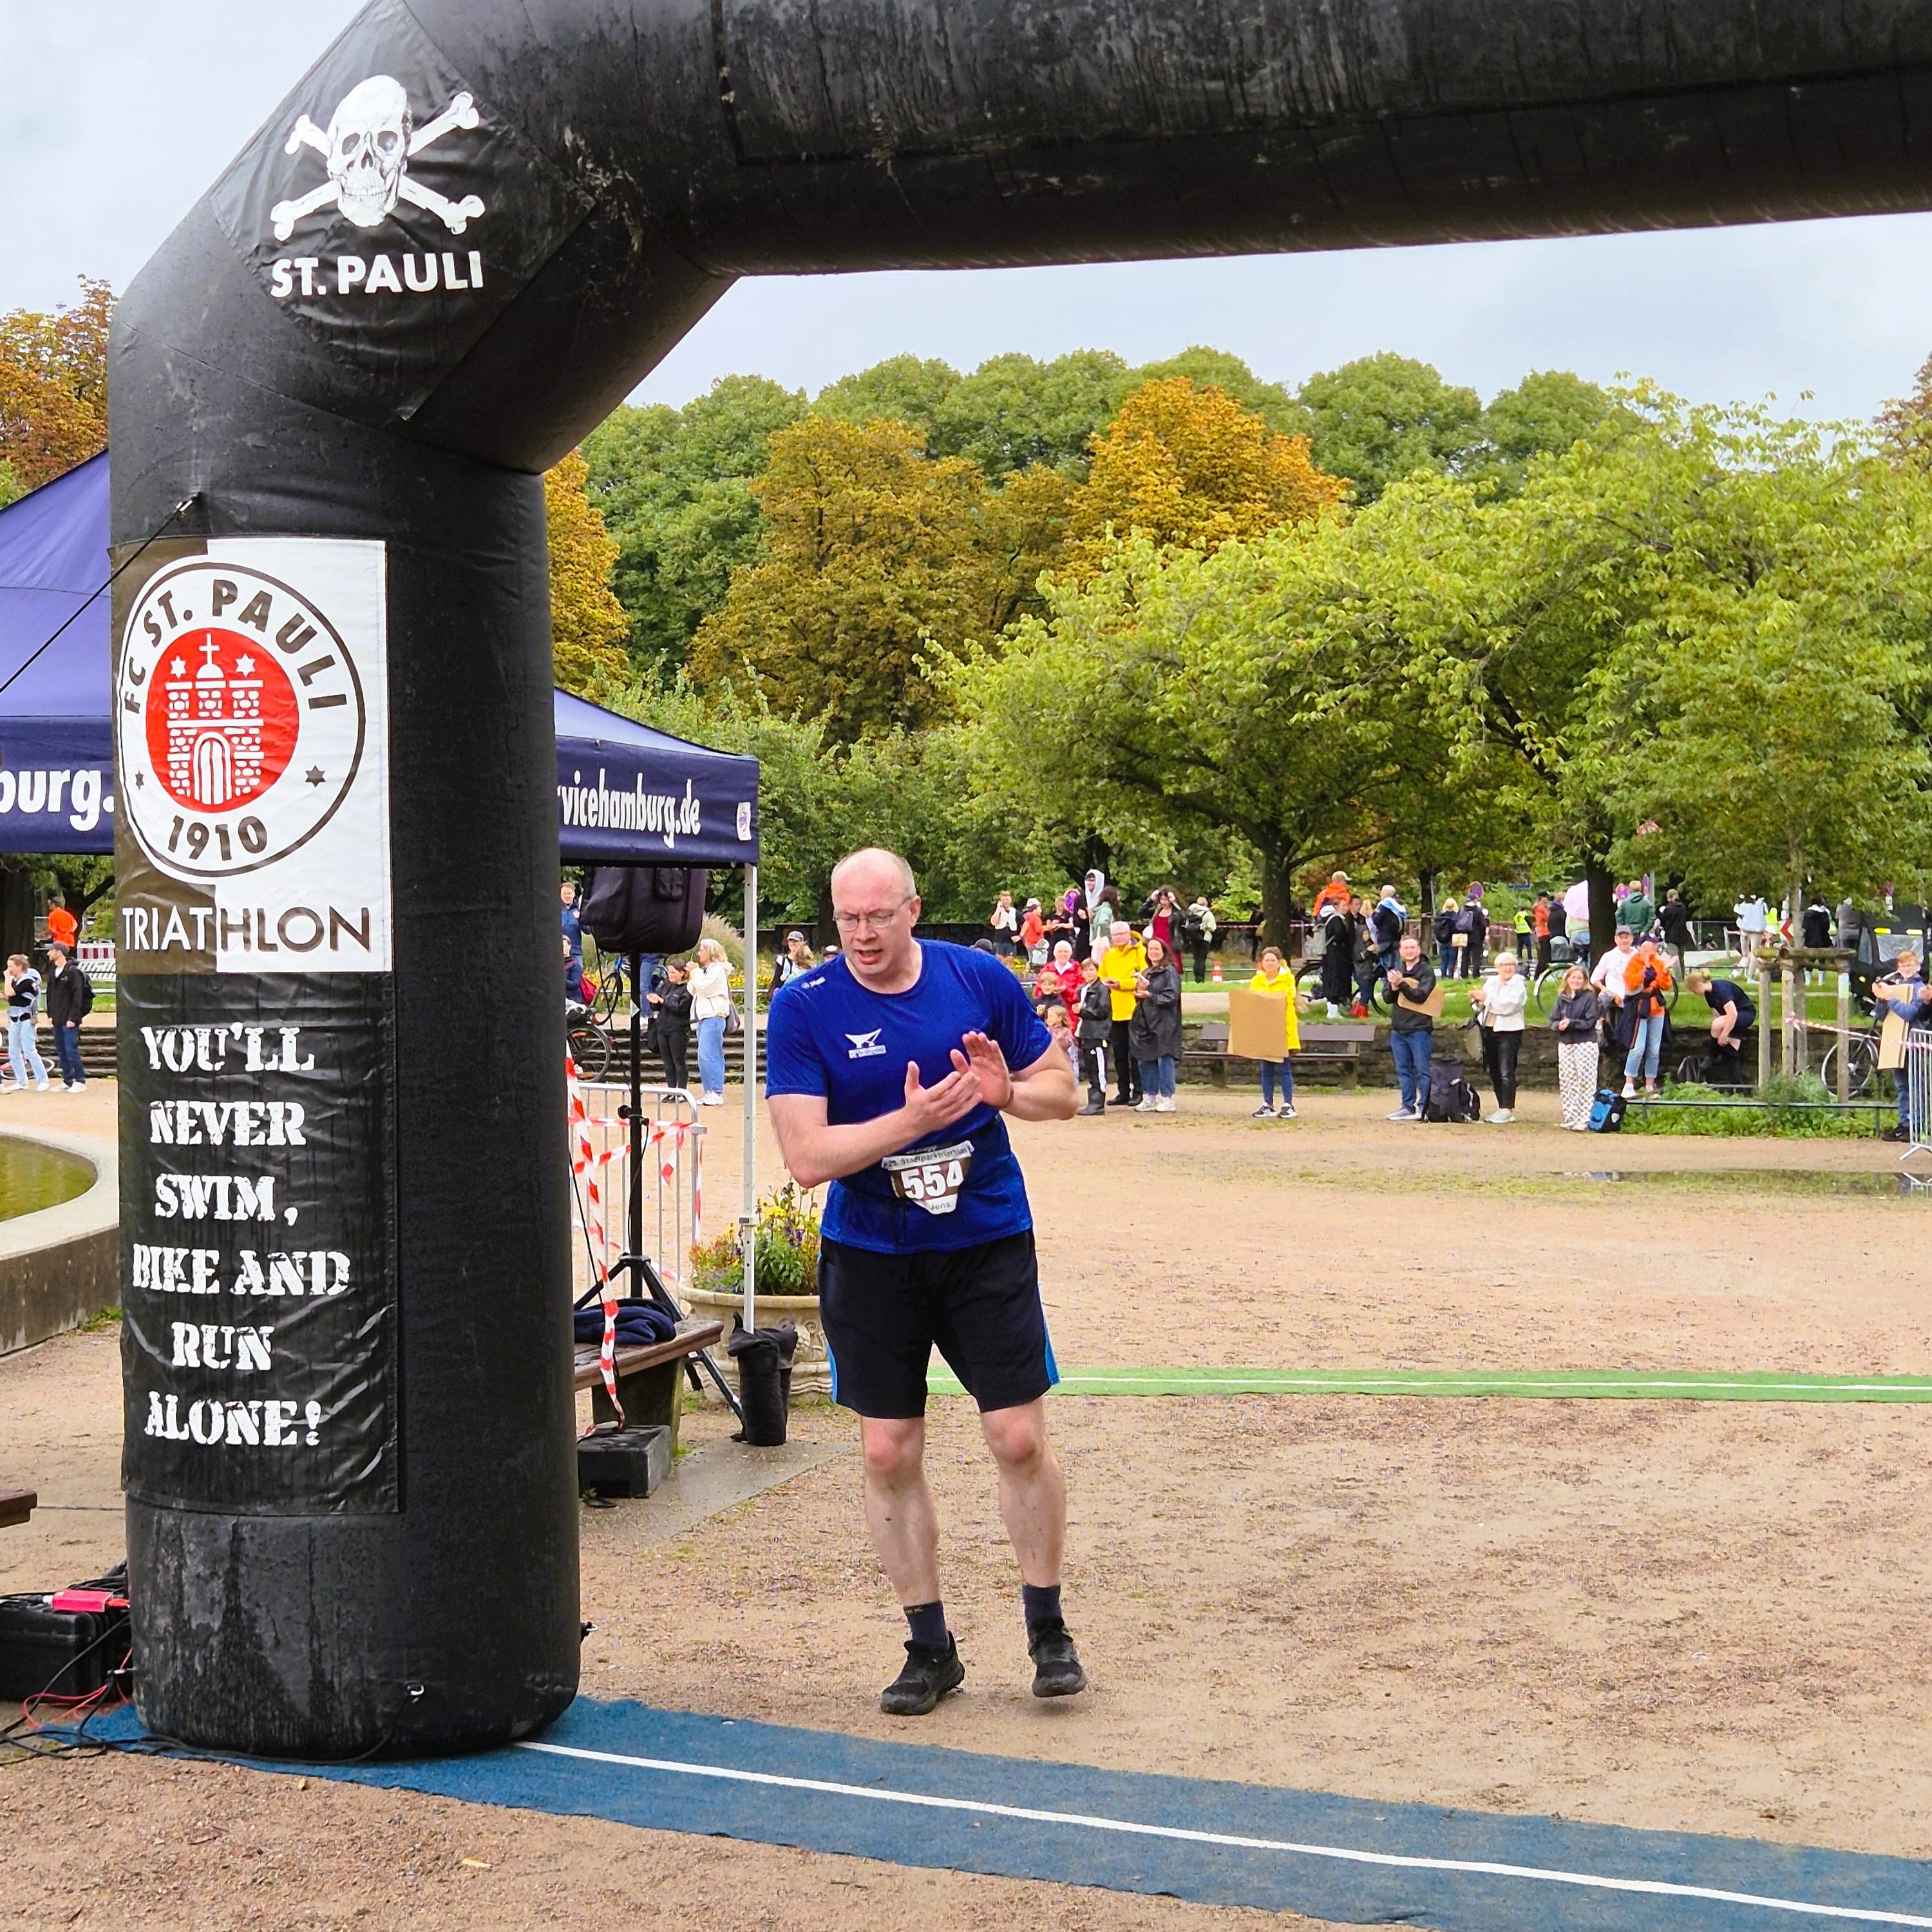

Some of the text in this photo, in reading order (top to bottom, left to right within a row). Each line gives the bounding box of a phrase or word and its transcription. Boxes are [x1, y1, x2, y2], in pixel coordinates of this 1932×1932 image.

[270, 251, 484, 297] ST. PAULI
[124, 579, 347, 714] FC ST. PAULI
[557, 768, 701, 849] vicehamburg.de
[168, 815, 267, 861] 1910
[122, 906, 371, 953] TRIATHLON
[140, 1021, 315, 1072] YOU'LL
[149, 1100, 306, 1146] NEVER
[155, 1173, 298, 1226] SWIM,
[133, 1244, 350, 1296] BIKE AND
[171, 1321, 274, 1370] RUN
[144, 1391, 322, 1446] ALONE!
